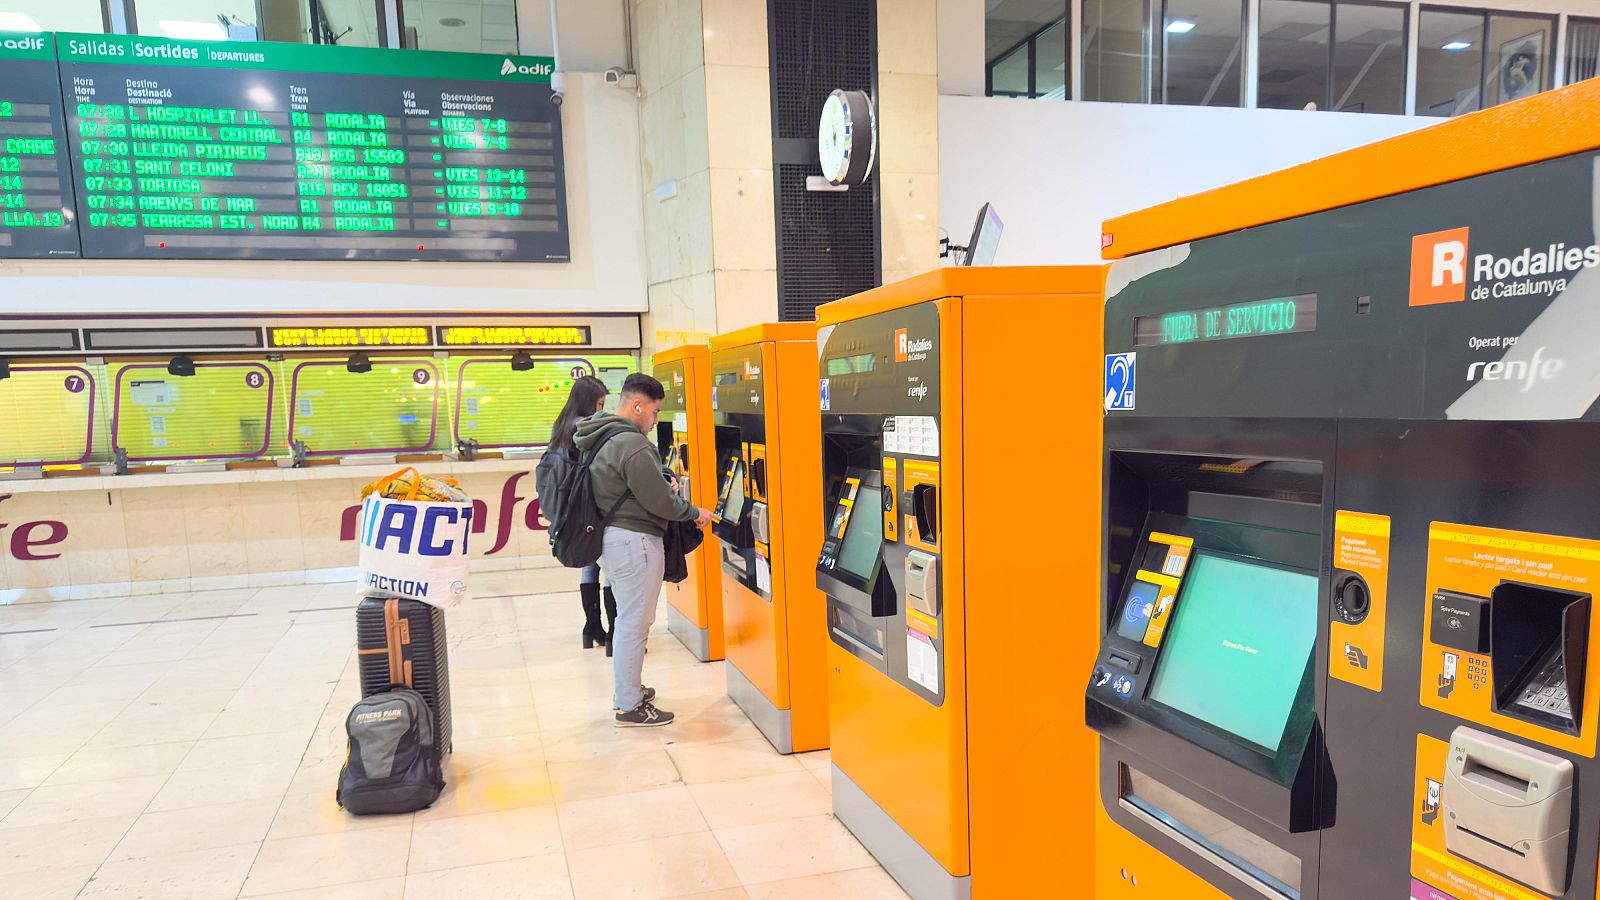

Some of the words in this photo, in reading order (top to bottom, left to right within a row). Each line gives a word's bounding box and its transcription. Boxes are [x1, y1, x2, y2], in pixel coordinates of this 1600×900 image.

[4, 38, 45, 50] adif
[69, 40, 125, 56] Salidas
[136, 43, 199, 60] Sortides
[211, 51, 265, 63] DEPARTURES
[518, 63, 551, 76] adif
[73, 77, 94, 86] Hora
[126, 79, 158, 88] Destino
[75, 86, 96, 96] Hora
[127, 88, 172, 98] Destinació
[290, 86, 307, 95] Tren
[403, 91, 416, 100] Vía
[441, 92, 495, 103] Observaciones
[128, 97, 163, 105] DESTINATION
[290, 94, 309, 103] Tren
[404, 99, 417, 108] Via
[442, 101, 492, 111] Observacions
[0, 101, 13, 117] 2
[128, 106, 140, 120] L
[146, 106, 237, 124] HOSPITALET
[244, 110, 271, 126] LL.
[291, 112, 311, 127] R1
[325, 112, 386, 130] RODALIA
[442, 117, 476, 131] VIES
[481, 118, 508, 133] 7-8
[79, 121, 127, 138] 07:28
[130, 123, 213, 141] MARTORELL
[219, 126, 282, 144] CENTRAL
[293, 129, 312, 144] R4
[327, 130, 388, 147] RODALIA
[443, 134, 477, 149] VIES
[482, 135, 508, 150] 7-8
[6, 138, 55, 155] CARRE
[81, 140, 129, 156] 07:30
[132, 142, 188, 158] LLEIDA
[195, 144, 267, 161] PIRINEUS
[328, 148, 357, 163] REG
[362, 148, 405, 164] 15503
[83, 158, 131, 173] 07:31
[135, 159, 172, 175] SANT
[179, 161, 234, 177] CELONI
[330, 164, 390, 181] RODALIA
[445, 167, 480, 182] VIES
[85, 176, 133, 191] 07:33
[137, 177, 202, 193] TORTOSA
[332, 182, 359, 197] REX
[366, 182, 408, 198] 18051
[447, 184, 481, 199] VIES
[487, 186, 527, 200] 11-12
[87, 194, 135, 210] 07:34
[138, 195, 194, 211] ARENYS
[200, 197, 220, 212] DE
[227, 197, 255, 212] MAR
[300, 199, 319, 214] R1
[333, 199, 394, 214] RODALIA
[447, 201, 482, 216] VIES
[487, 202, 520, 217] 9-10
[4, 211, 63, 227] LLA.13
[89, 212, 137, 228] 07:35
[141, 213, 214, 229] TERRASSA
[219, 215, 255, 229] EST.
[261, 215, 299, 230] NORD
[301, 215, 320, 230] R4
[335, 216, 395, 231] RODALIA
[1431, 240, 1466, 287] R
[1473, 242, 1600, 283] Rodalies
[1470, 284, 1490, 301] de
[1492, 278, 1567, 299] Catalunya
[1163, 314, 1200, 344] FUERA
[1206, 310, 1221, 338] DE
[1227, 300, 1297, 338] SERVICIO
[908, 338, 932, 353] Rodalies
[1468, 336, 1501, 351] Operat
[1502, 336, 1521, 350] per
[417, 370, 426, 383] 9
[571, 368, 586, 380] 10
[1466, 346, 1568, 394] renfe
[69, 378, 79, 391] 7
[250, 374, 260, 388] 8
[908, 381, 927, 401] renfe
[0, 493, 69, 561] e
[1473, 551, 1495, 561] Lector
[1495, 555, 1521, 567] targeta
[1525, 560, 1538, 569] pin
[1538, 561, 1554, 571] pad
[1511, 564, 1527, 574] Card
[1527, 567, 1547, 577] reader
[369, 573, 429, 597] ACTION
[355, 711, 383, 722] FITNESS
[382, 709, 402, 719] PARK
[1447, 871, 1477, 889] Pagament
[1478, 887, 1494, 898] amb
